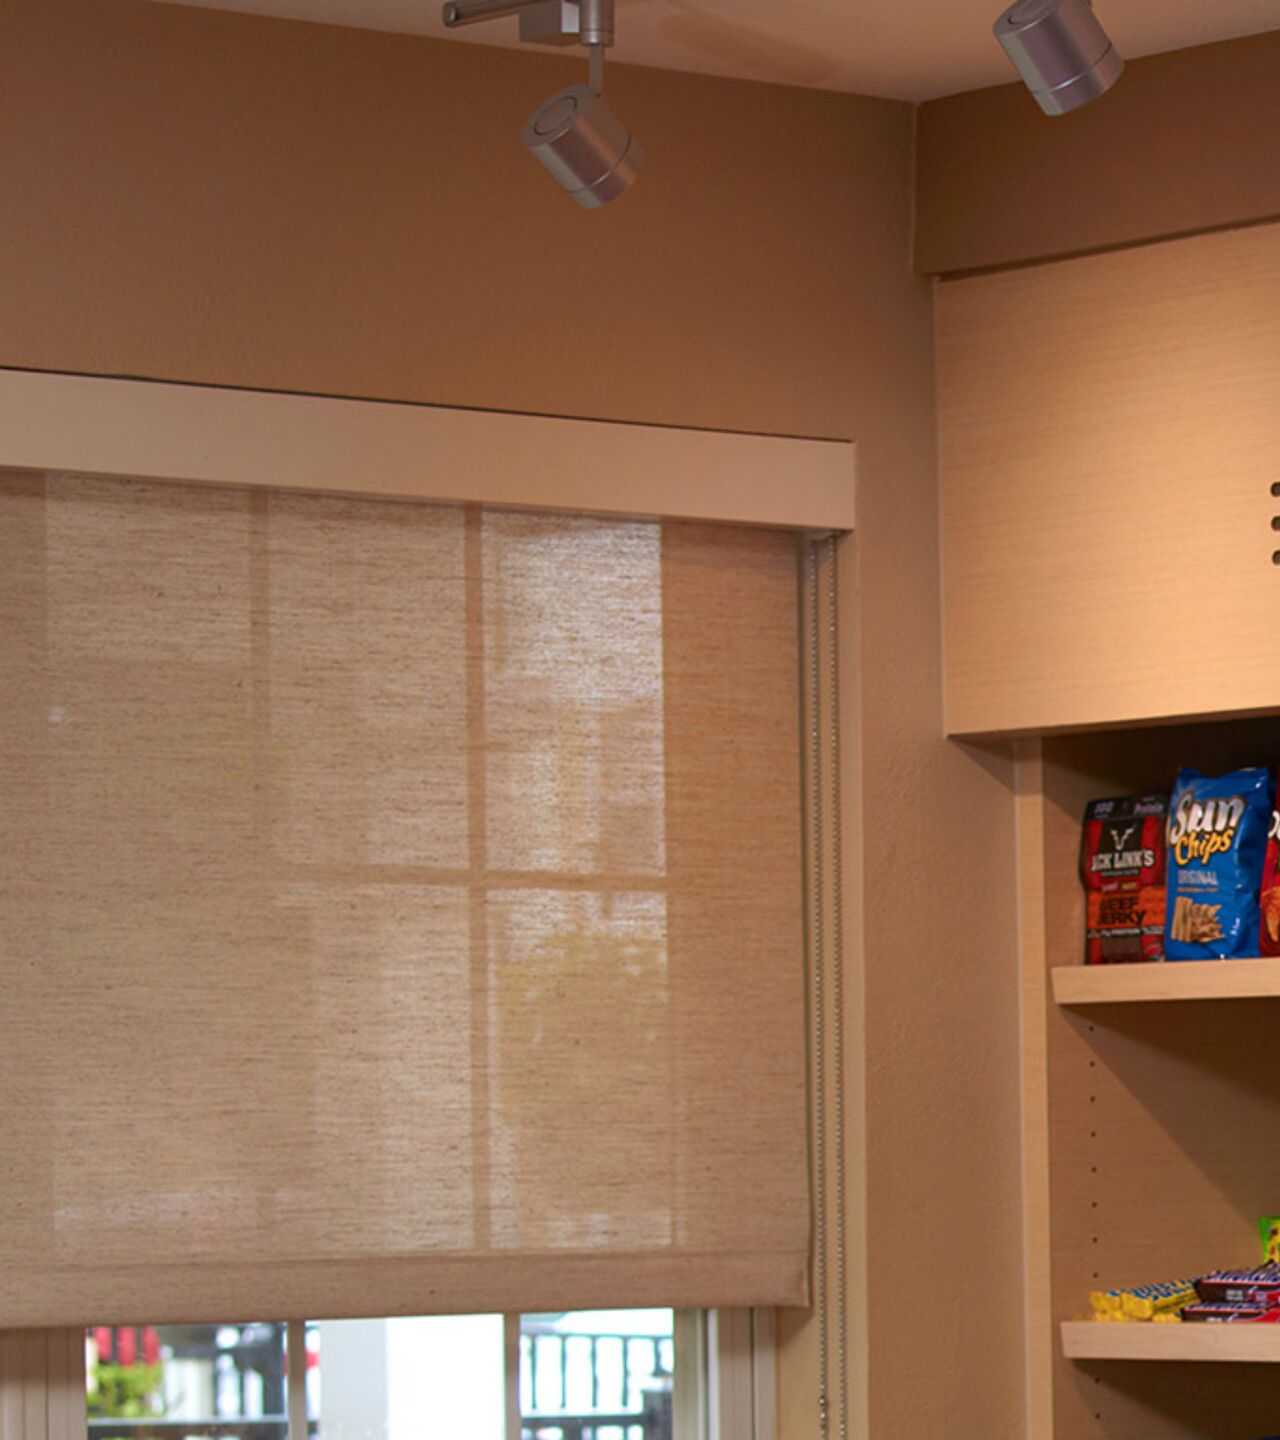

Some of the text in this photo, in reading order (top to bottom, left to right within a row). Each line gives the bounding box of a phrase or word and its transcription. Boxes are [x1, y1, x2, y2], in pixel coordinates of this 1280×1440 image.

[1170, 790, 1245, 845] Sun
[1114, 850, 1155, 868] LINK'S
[1175, 828, 1234, 866] Chips
